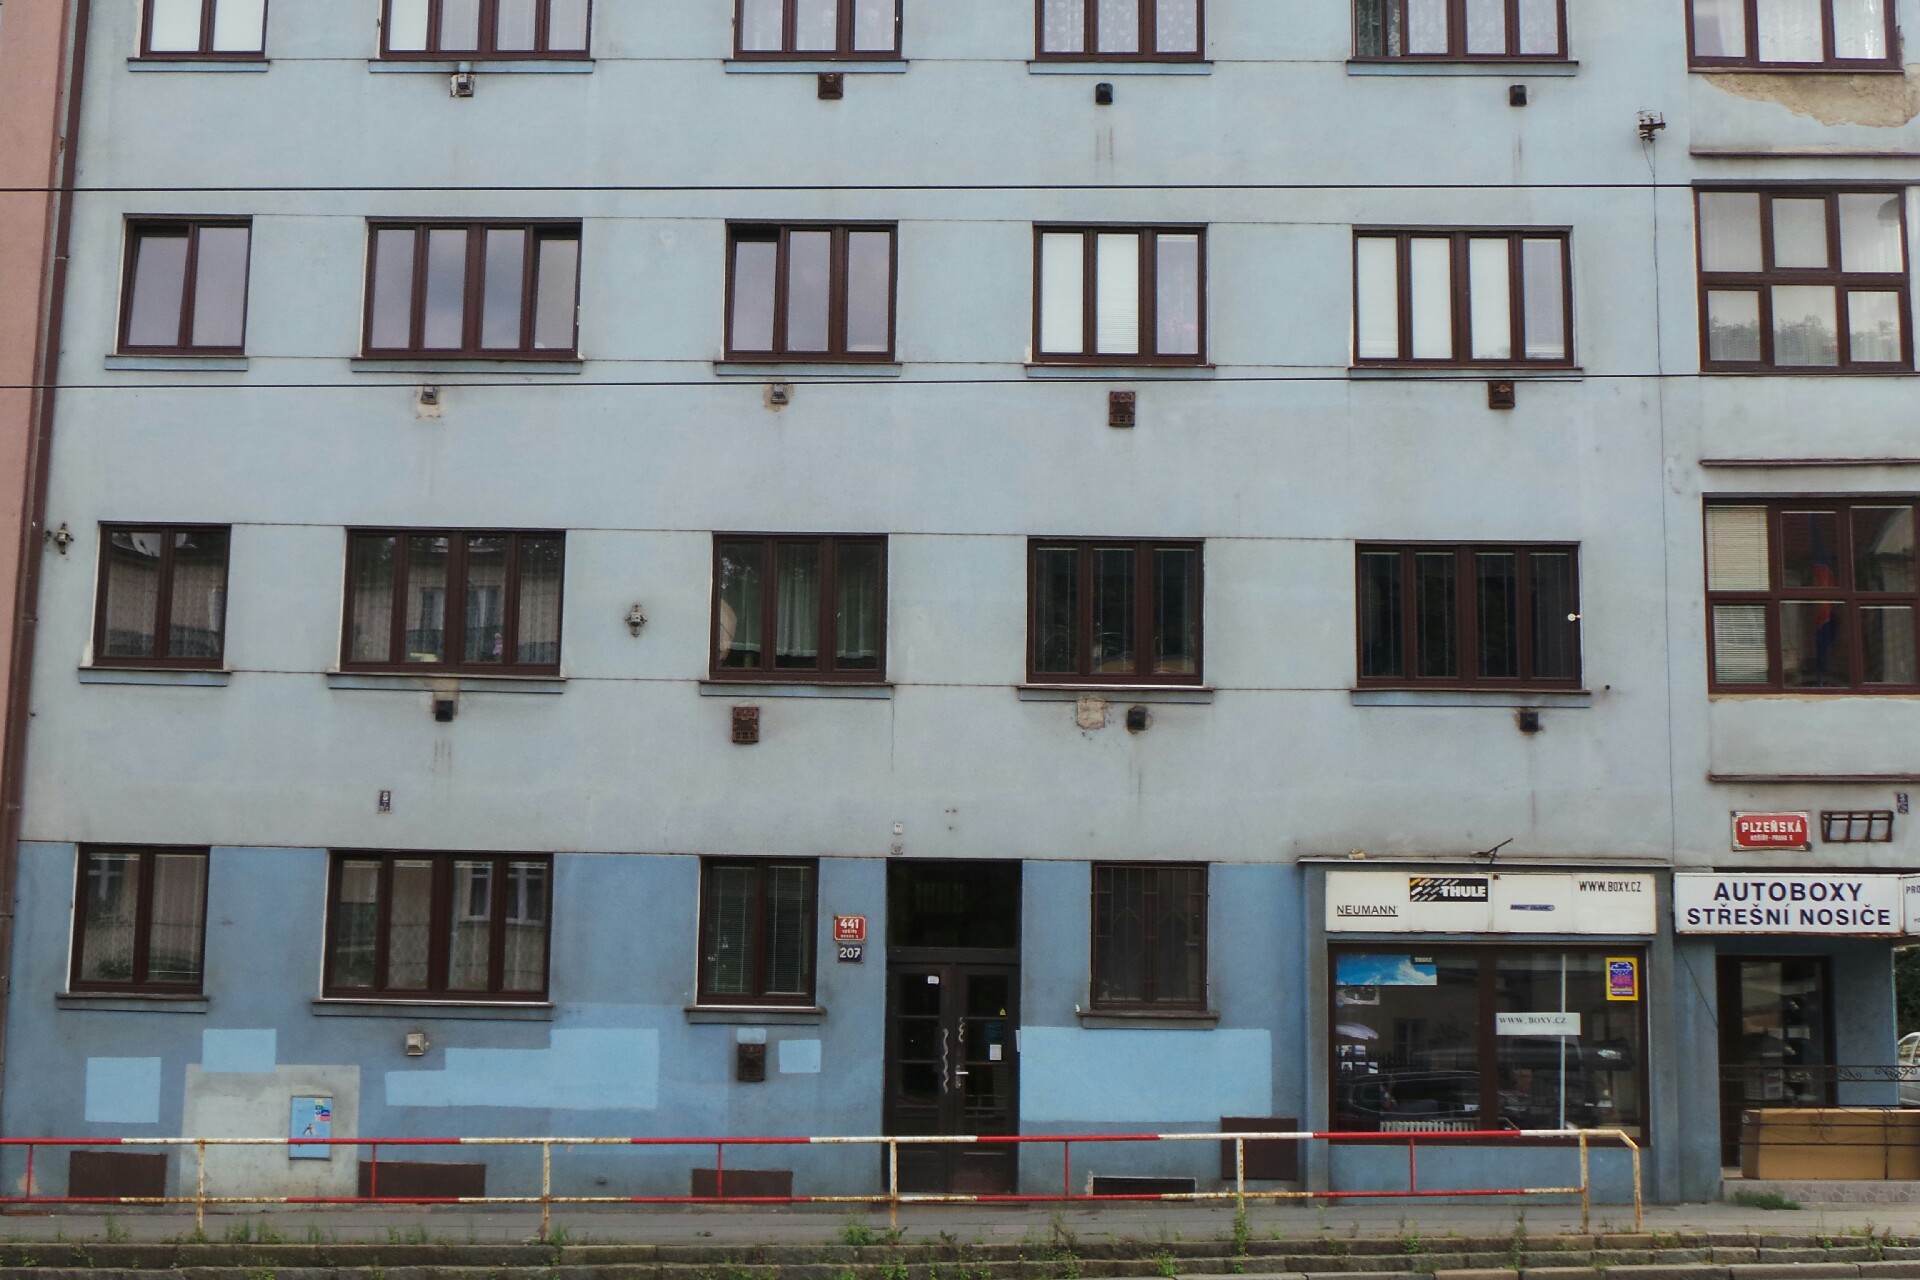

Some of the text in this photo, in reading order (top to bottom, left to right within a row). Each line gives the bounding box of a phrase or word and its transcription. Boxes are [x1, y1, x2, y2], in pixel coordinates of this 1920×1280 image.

[1741, 819, 1802, 833] PLZEŇSKÁ
[1441, 886, 1486, 897] THULE
[1579, 881, 1642, 892] WWW.BOXY.CZ
[1713, 882, 1863, 902] AUTOBOXY
[1336, 905, 1397, 915] NEUMANN
[1686, 903, 1891, 926] STŘEŠNÍ NOSIČE
[840, 918, 859, 929] 441
[839, 947, 861, 959] 207
